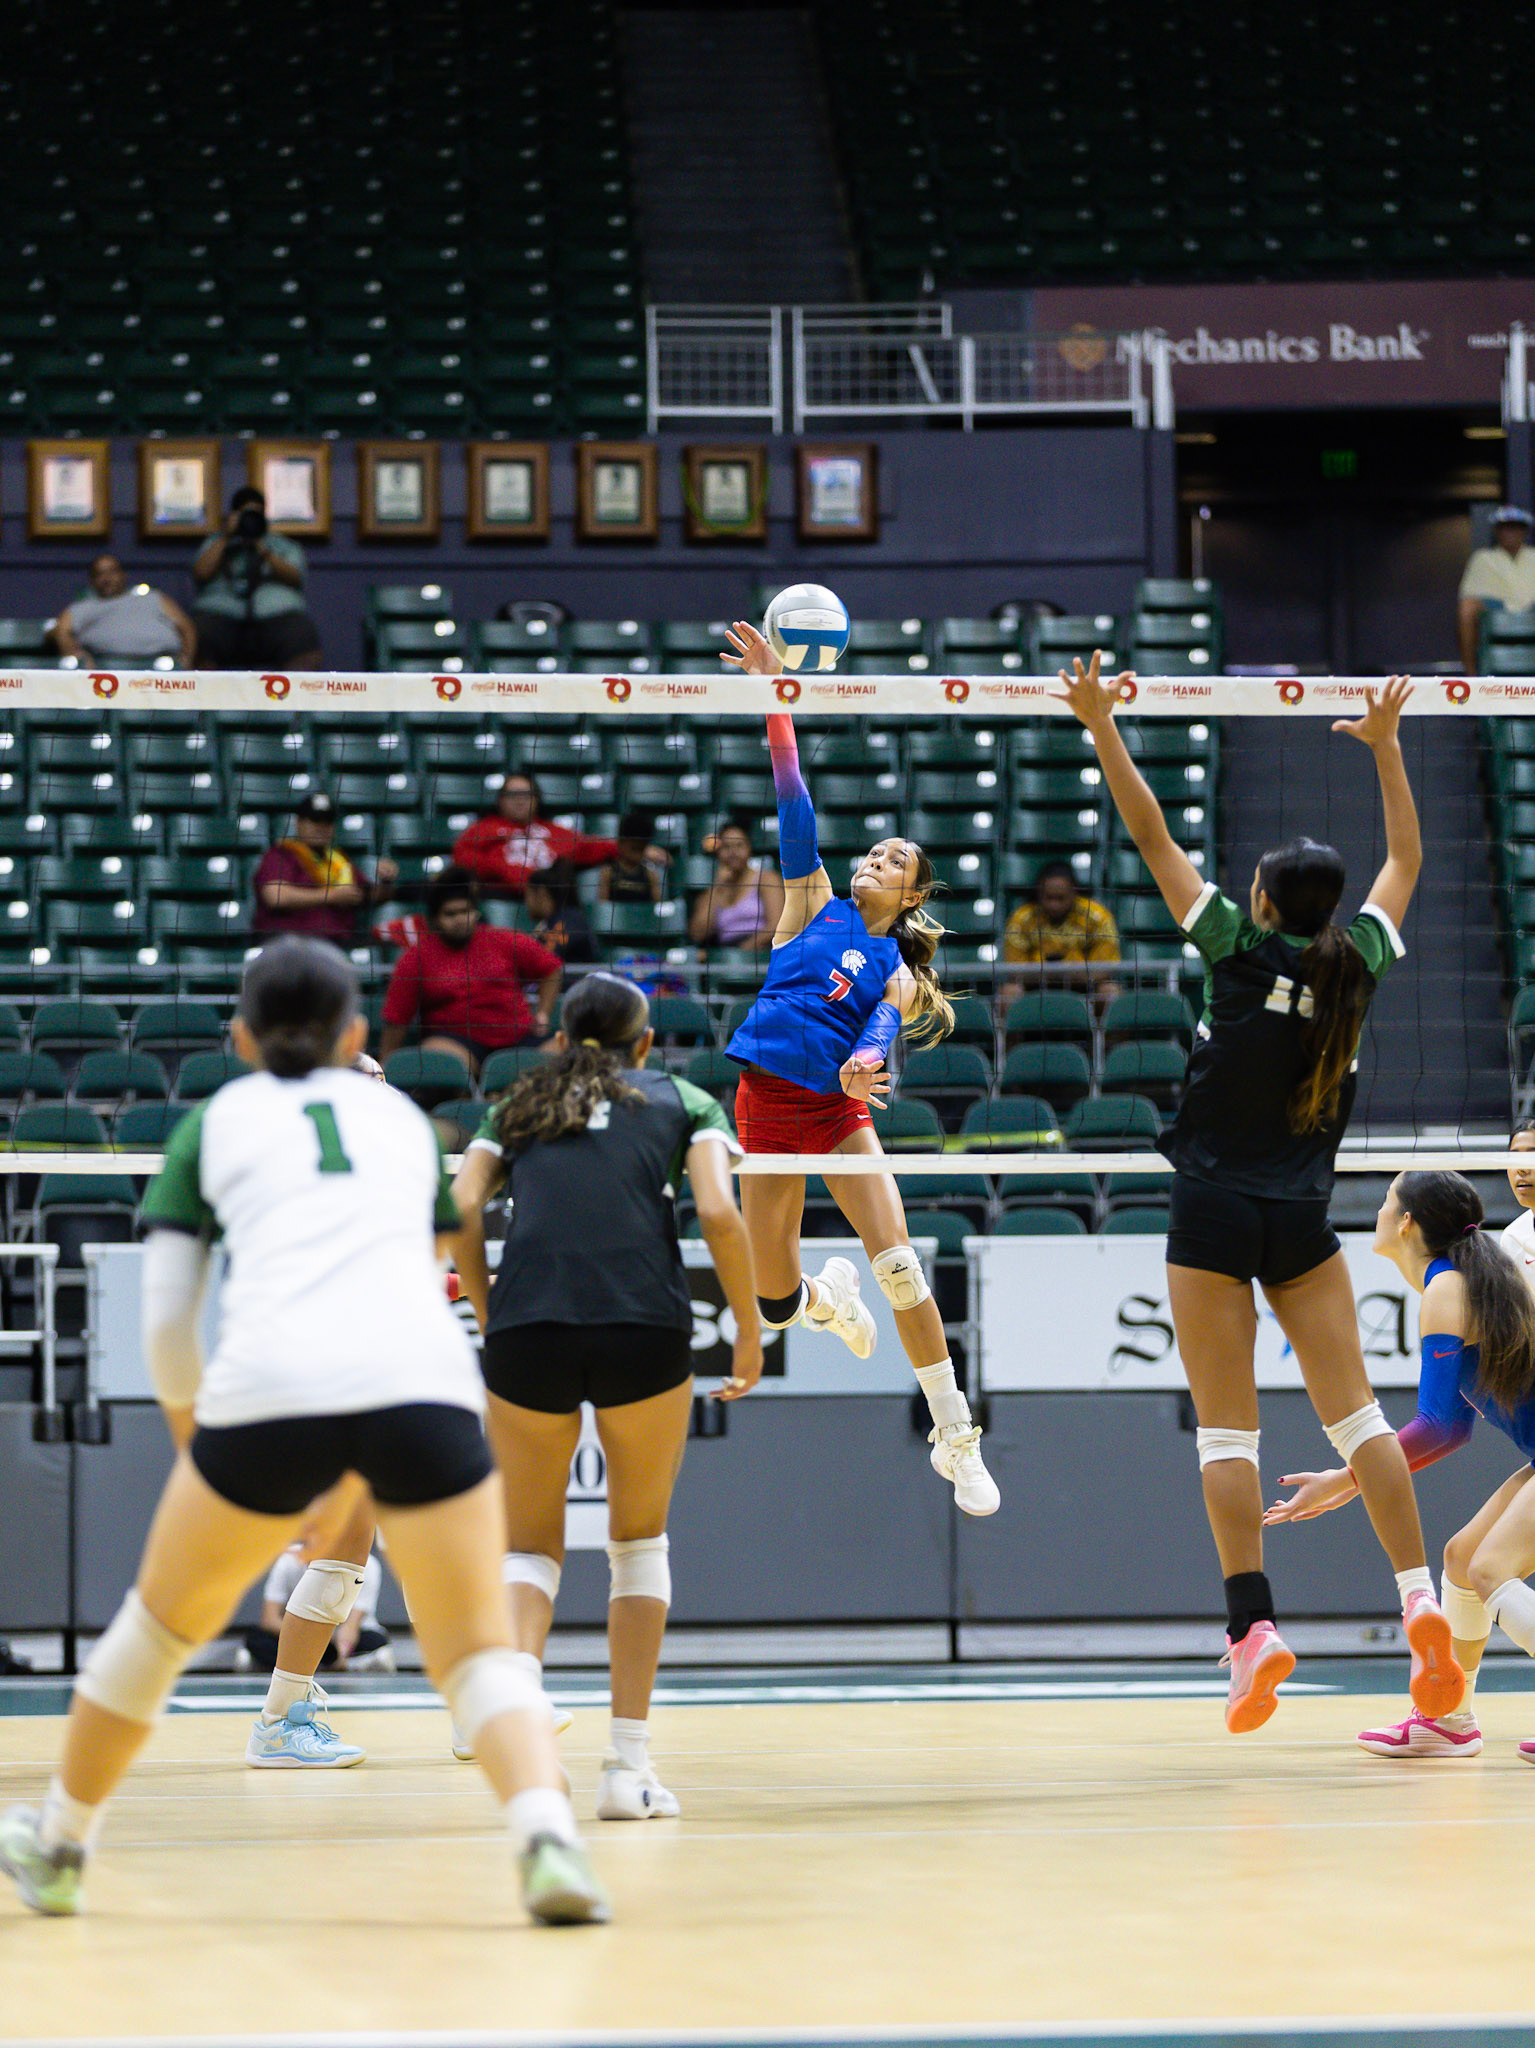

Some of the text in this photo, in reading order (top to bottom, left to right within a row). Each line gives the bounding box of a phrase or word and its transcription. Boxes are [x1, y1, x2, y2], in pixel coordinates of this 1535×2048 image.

[1329, 322, 1424, 362] Bank
[155, 679, 196, 690] HAWAII
[327, 681, 367, 692] HAWAII
[497, 682, 538, 693] HAWAII
[667, 683, 707, 695] HAWAII
[837, 684, 877, 695] HAWAII
[1005, 684, 1045, 695] HAWAII
[1173, 685, 1212, 696] HAWAII
[1339, 685, 1379, 696] HAWII
[820, 968, 854, 1003] 7
[302, 1102, 353, 1173] 1
